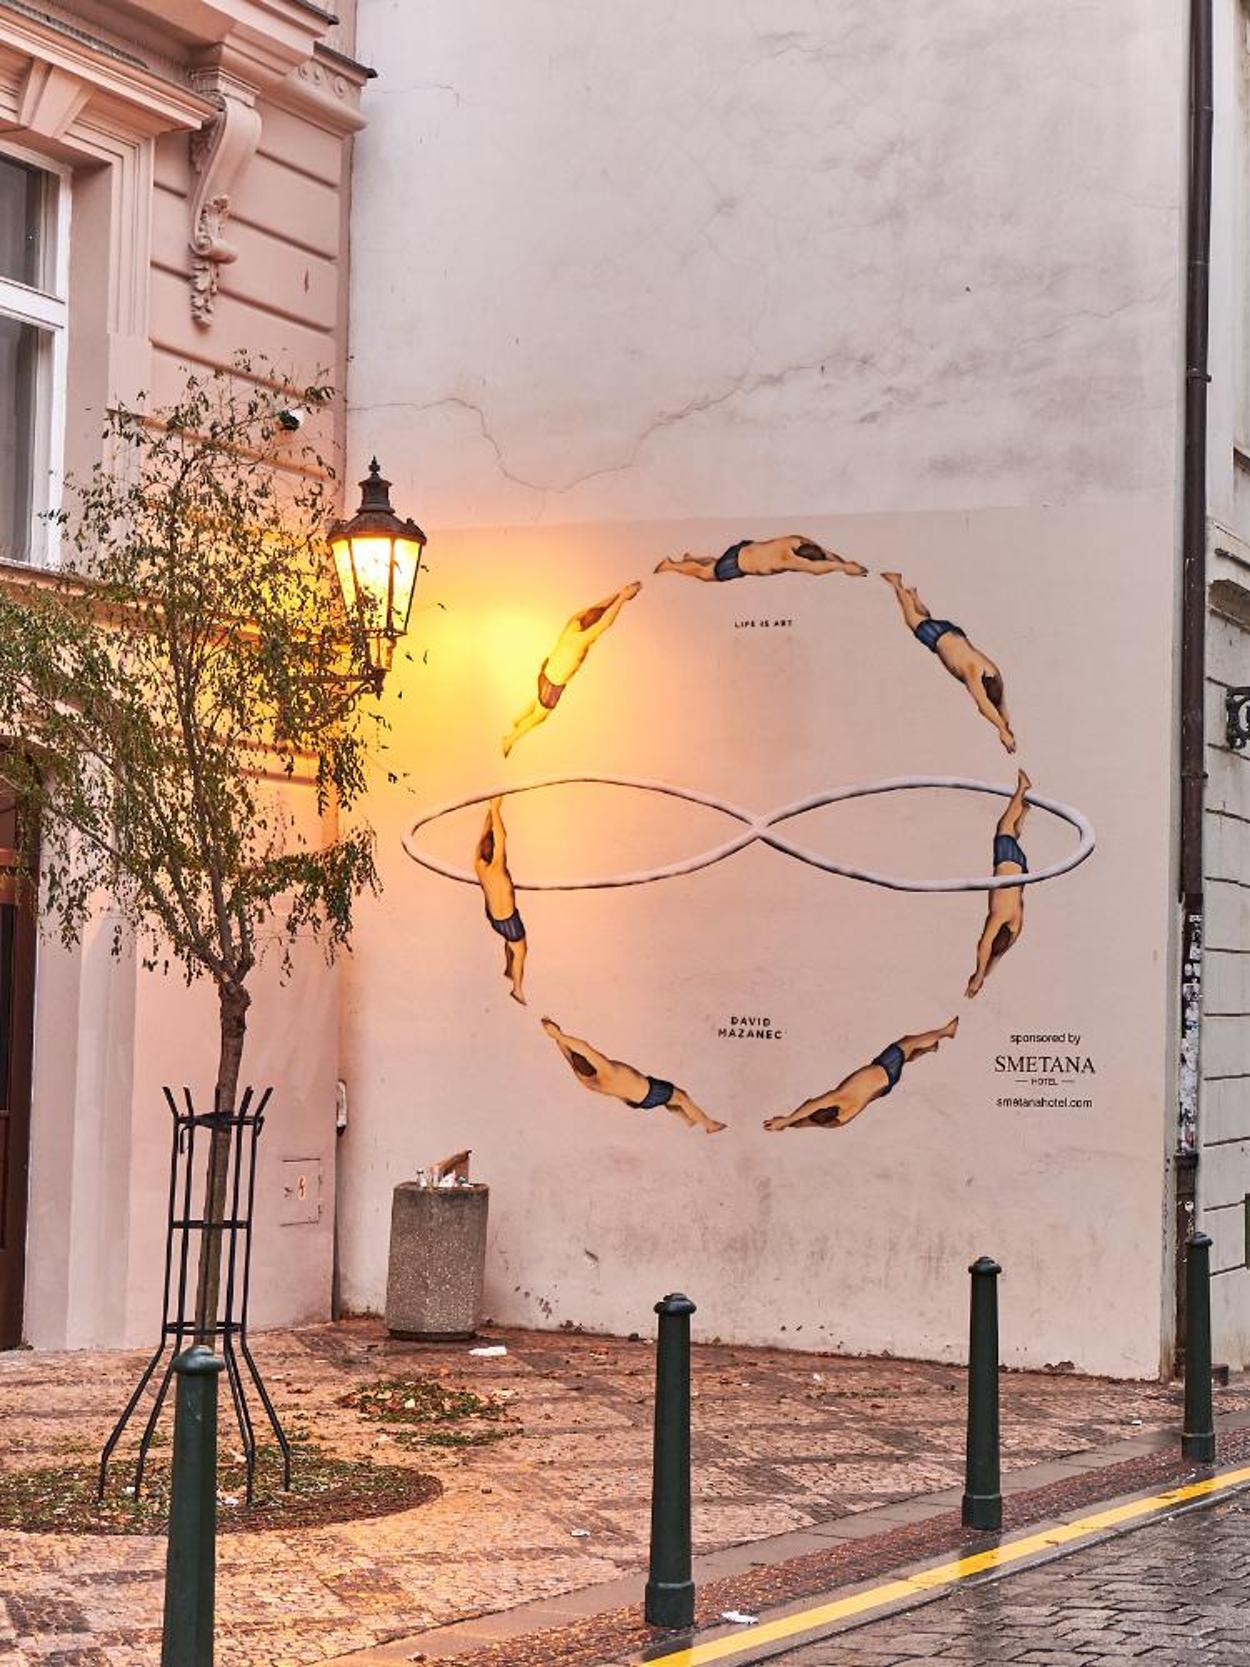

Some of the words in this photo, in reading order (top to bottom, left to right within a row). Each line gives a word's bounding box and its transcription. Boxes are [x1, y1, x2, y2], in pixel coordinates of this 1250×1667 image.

[734, 620, 755, 628] LIFE
[760, 620, 769, 628] IS
[773, 619, 792, 627] ART
[731, 1016, 771, 1027] DAVID
[718, 1028, 782, 1040] MAZANEC
[1010, 1033, 1066, 1045] sponsored
[1068, 1033, 1081, 1045] by
[994, 1055, 1096, 1073] SMETANA
[1031, 1078, 1058, 1086] HOTEL
[996, 1097, 1093, 1108] smetanahotel.com
